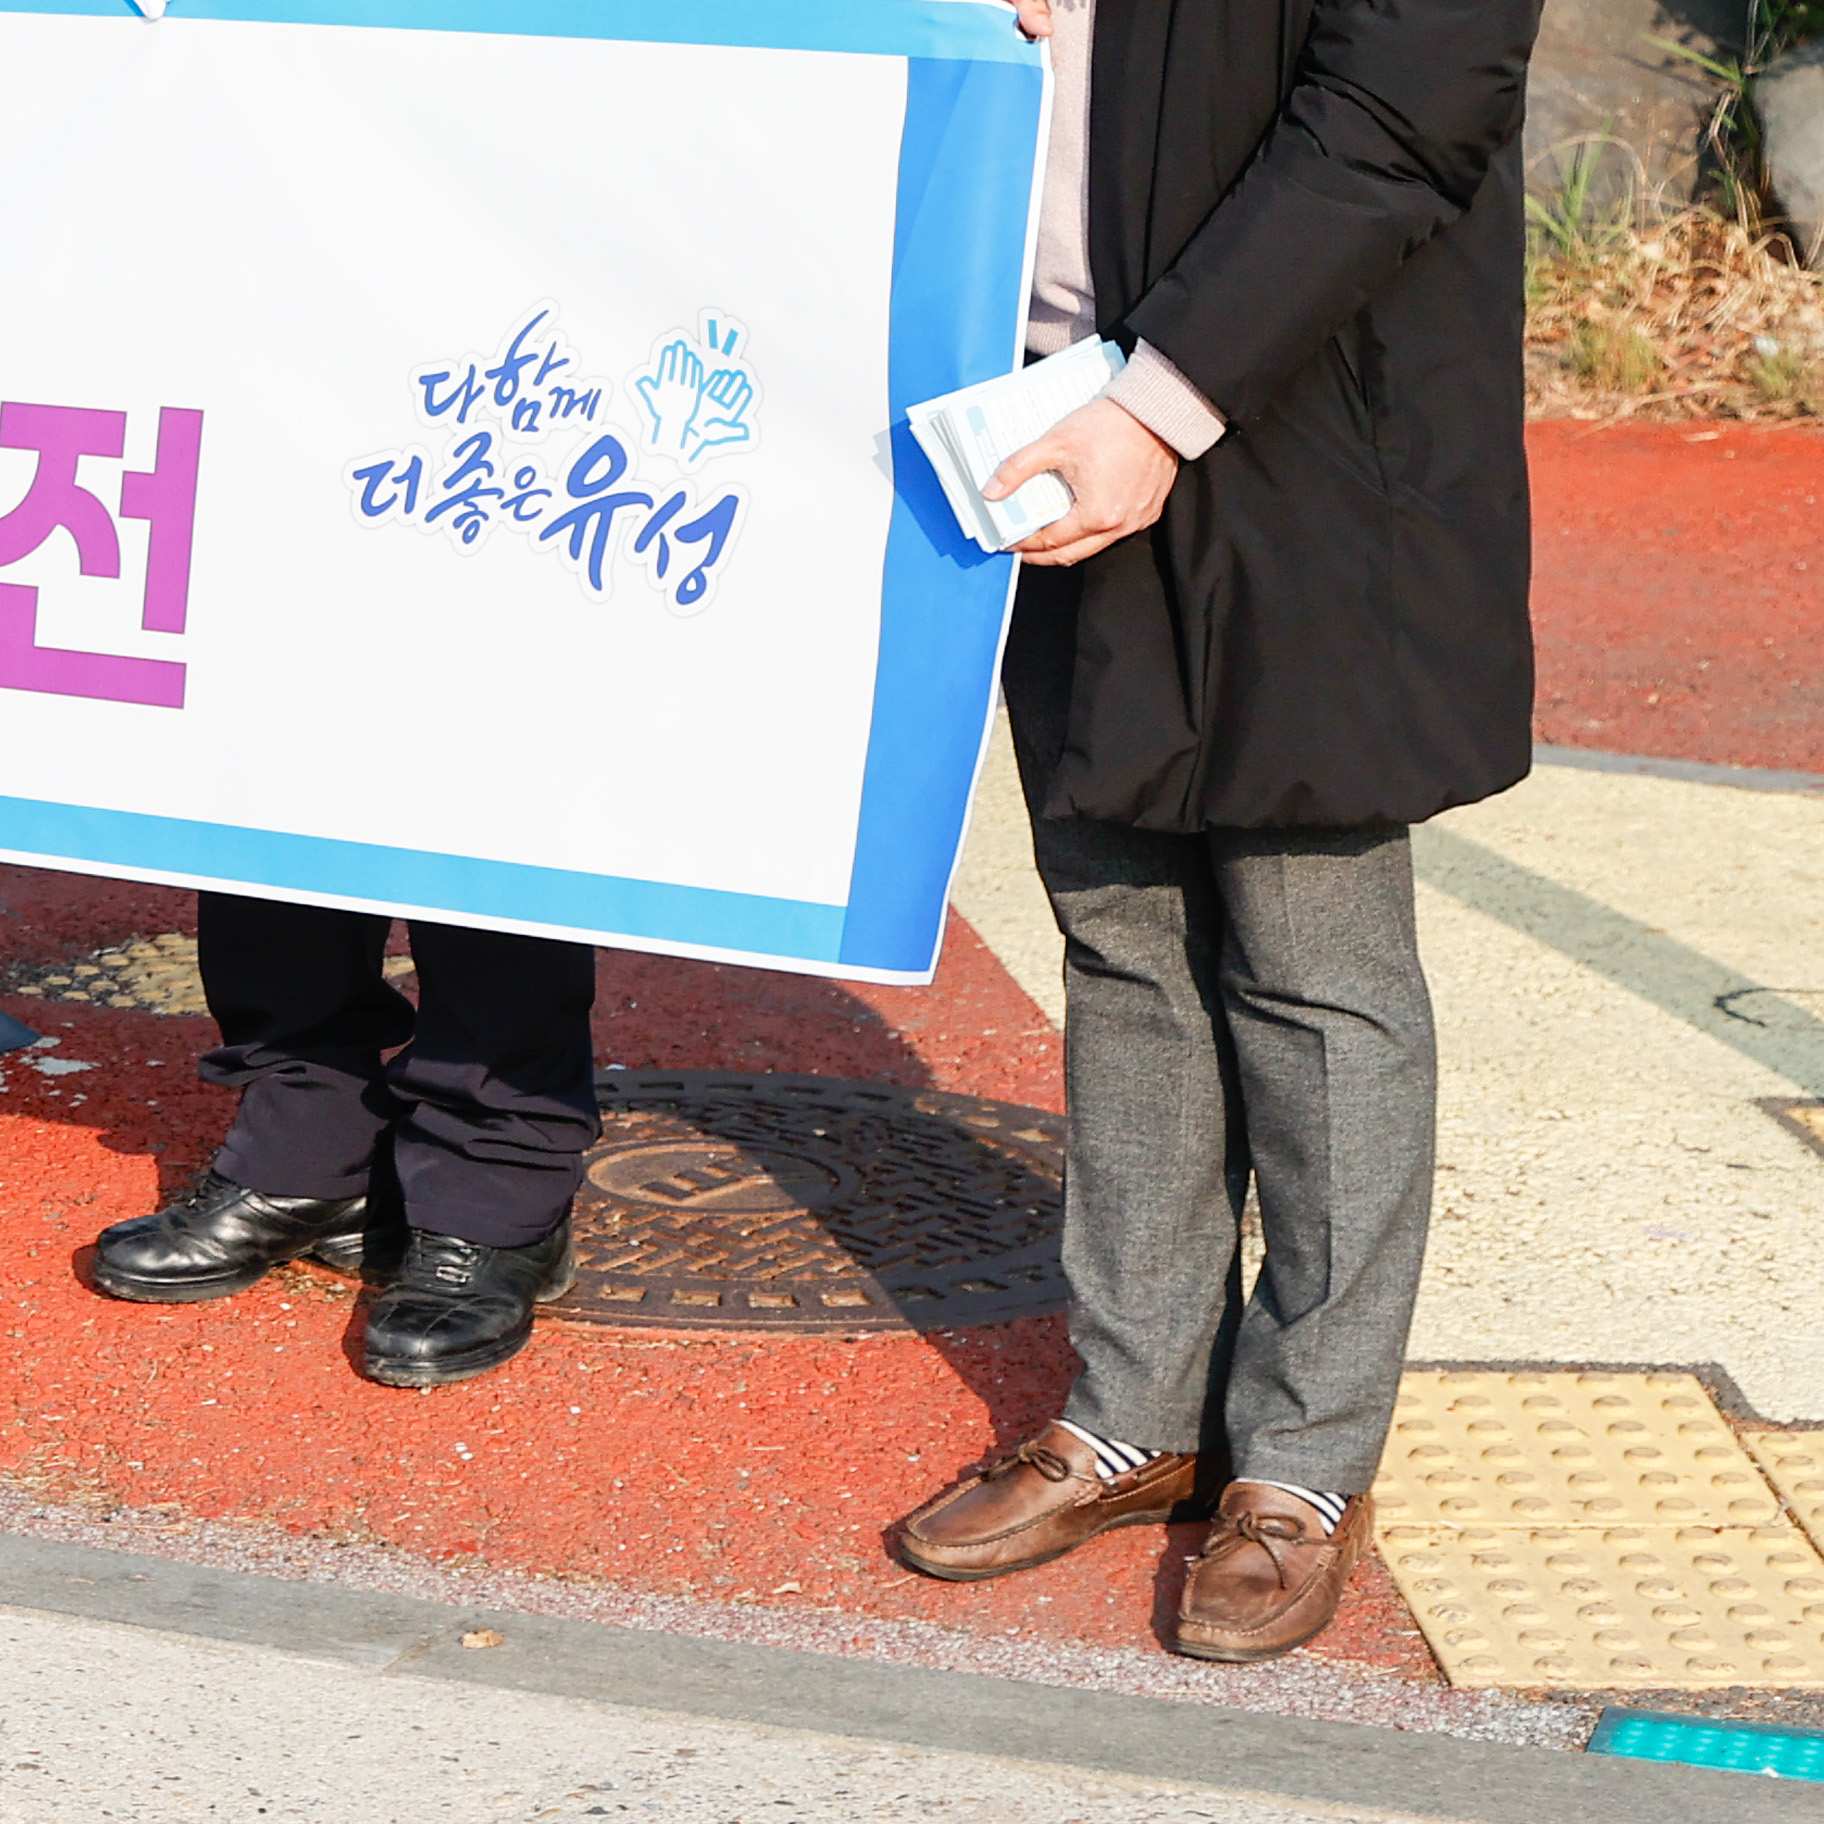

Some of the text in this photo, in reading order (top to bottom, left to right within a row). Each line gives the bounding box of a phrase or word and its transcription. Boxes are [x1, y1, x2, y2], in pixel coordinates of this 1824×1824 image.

[419, 308, 602, 433] 다함께
[352, 431, 740, 606] 더 좋은 유성
